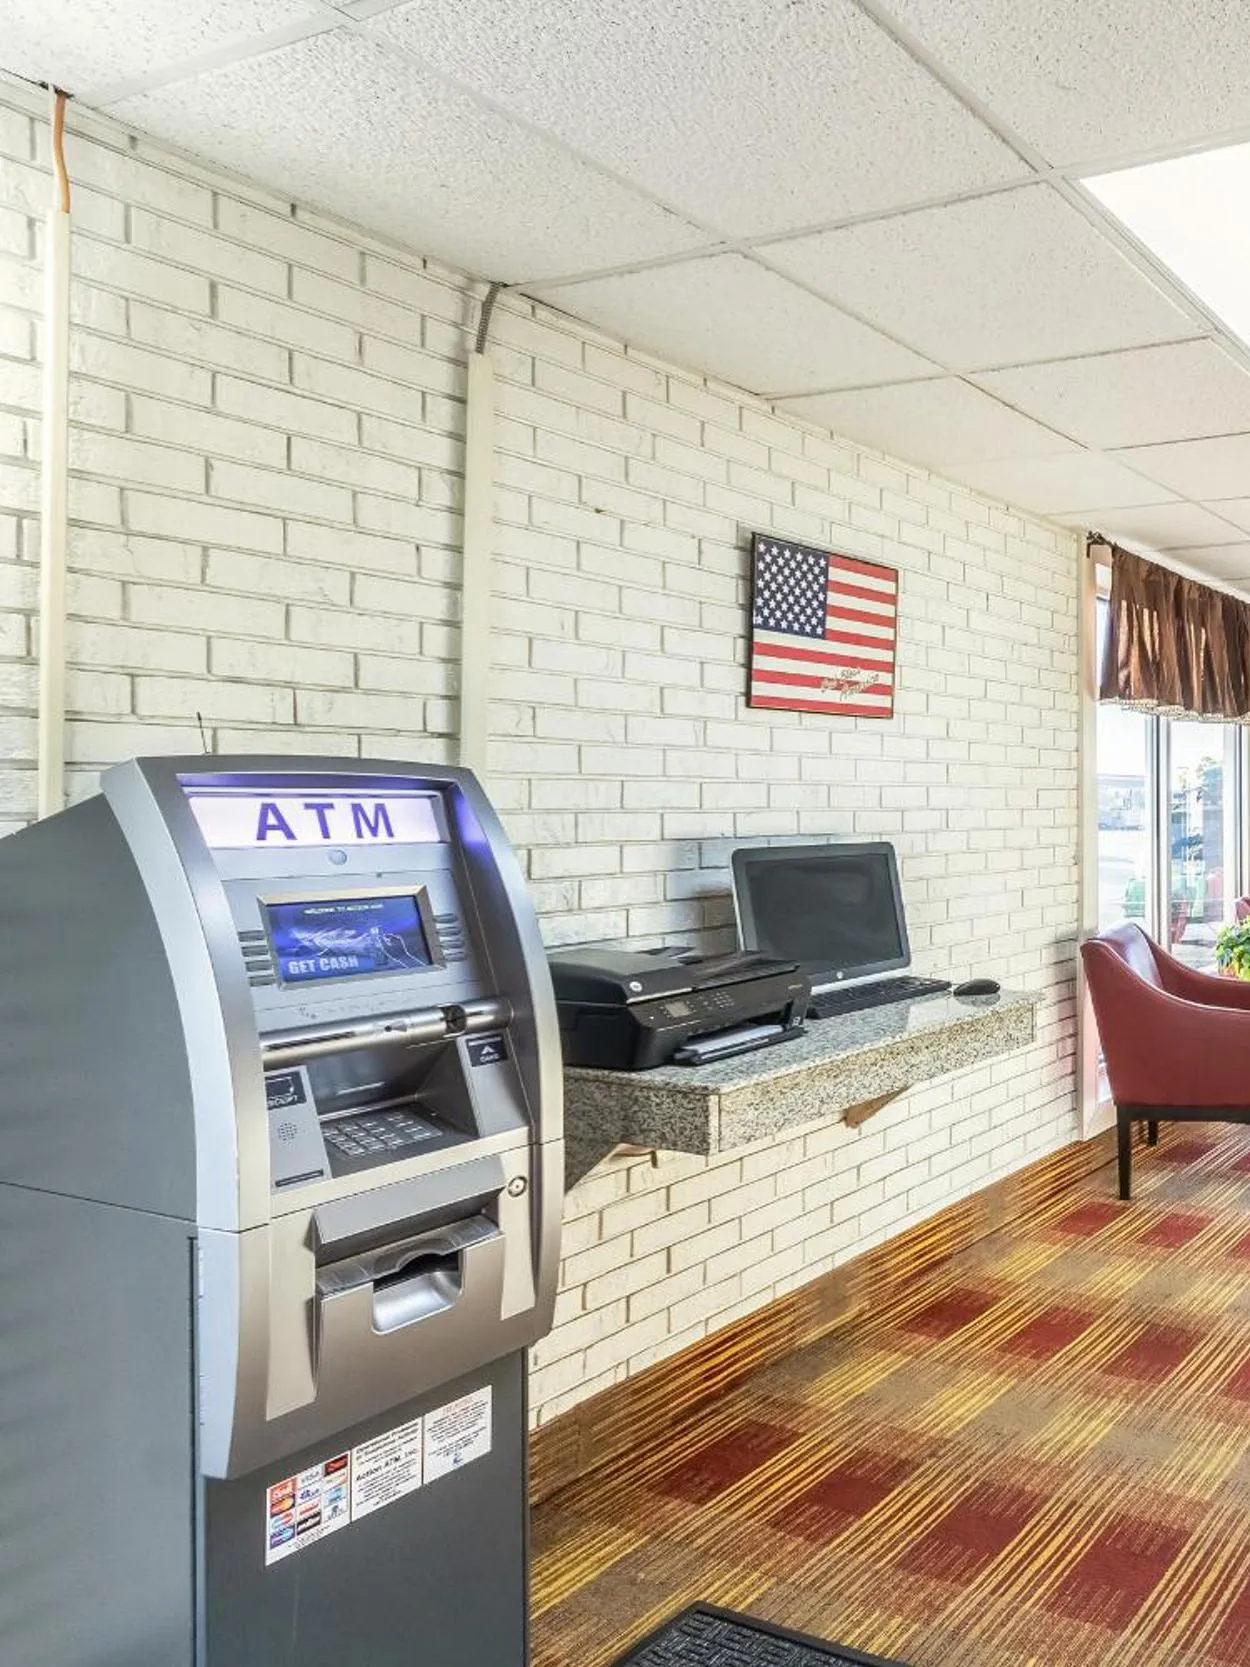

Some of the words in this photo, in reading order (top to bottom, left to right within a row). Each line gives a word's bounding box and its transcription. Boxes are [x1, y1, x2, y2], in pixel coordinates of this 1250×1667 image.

[256, 801, 395, 841] ATM
[288, 958, 316, 975] GET
[319, 955, 359, 971] CASH
